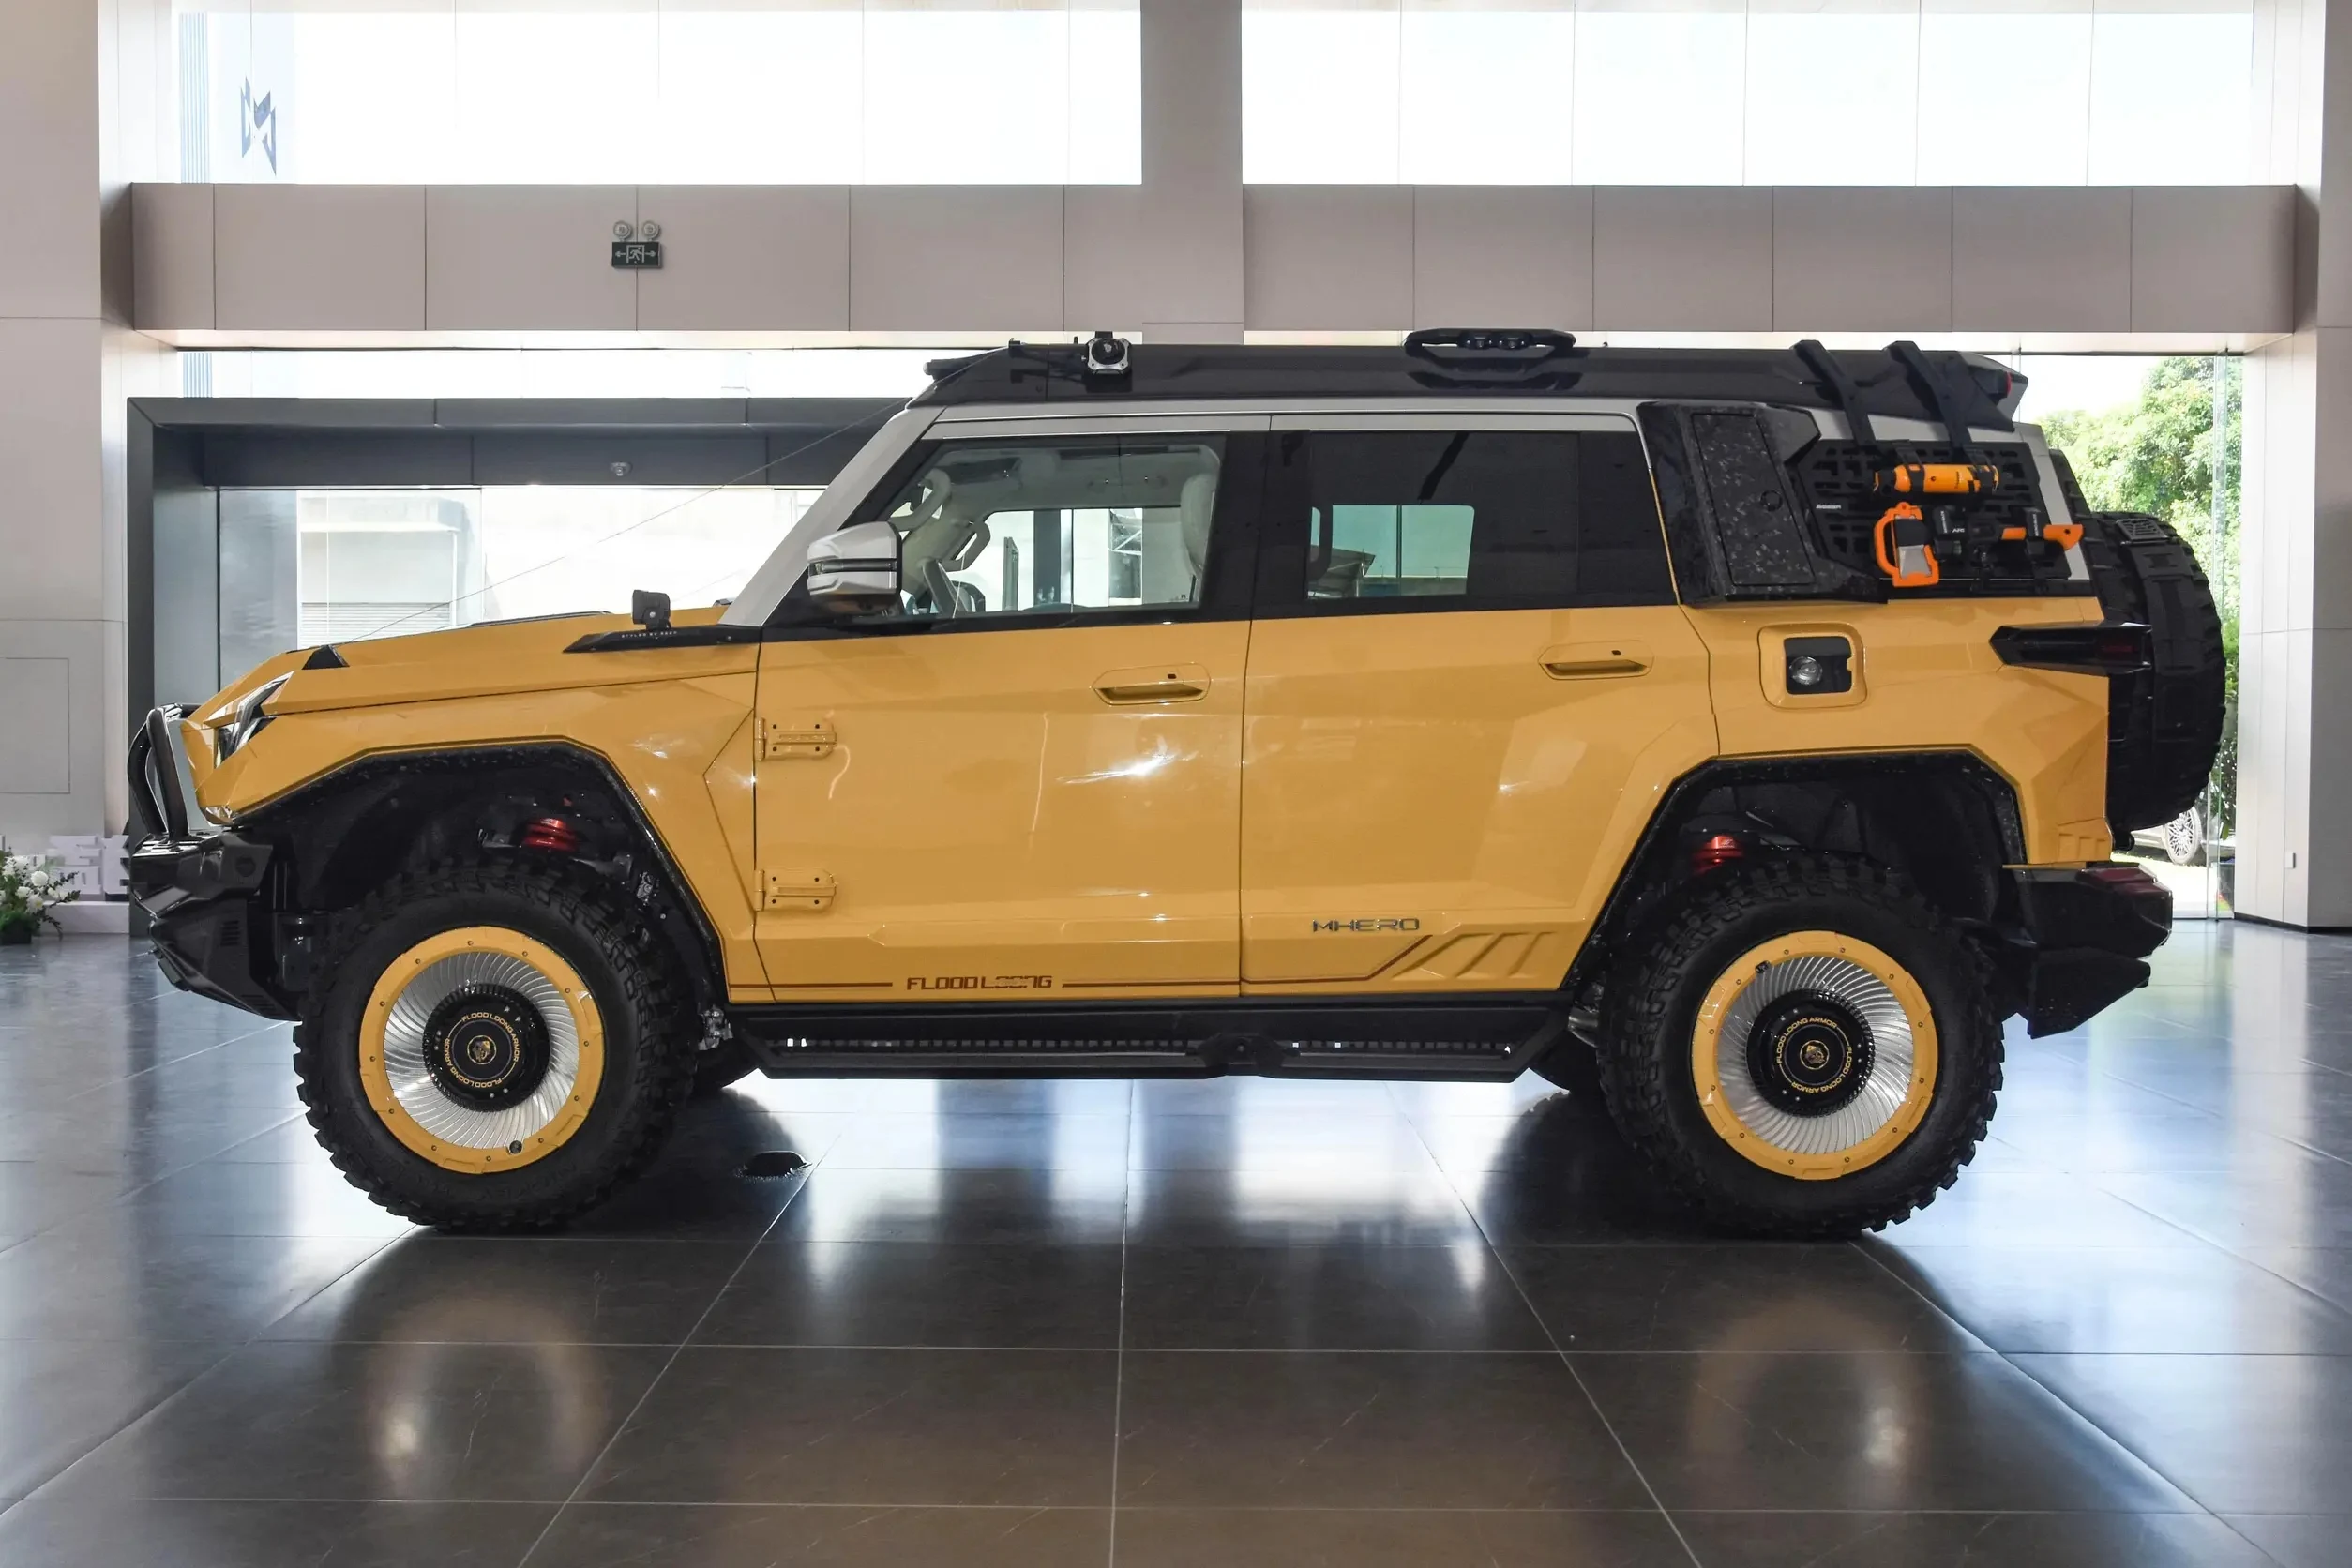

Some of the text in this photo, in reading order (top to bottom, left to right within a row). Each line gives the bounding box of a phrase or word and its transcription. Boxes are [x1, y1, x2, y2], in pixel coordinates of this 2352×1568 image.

[1312, 918, 1420, 933] MHERO
[907, 976, 978, 990] FLOOD
[462, 1012, 520, 1062] FLOOD LOONG ARMOR
[1776, 1017, 1837, 1063] FLOOD LOONG ARMOR
[444, 1038, 453, 1066] ARMOR
